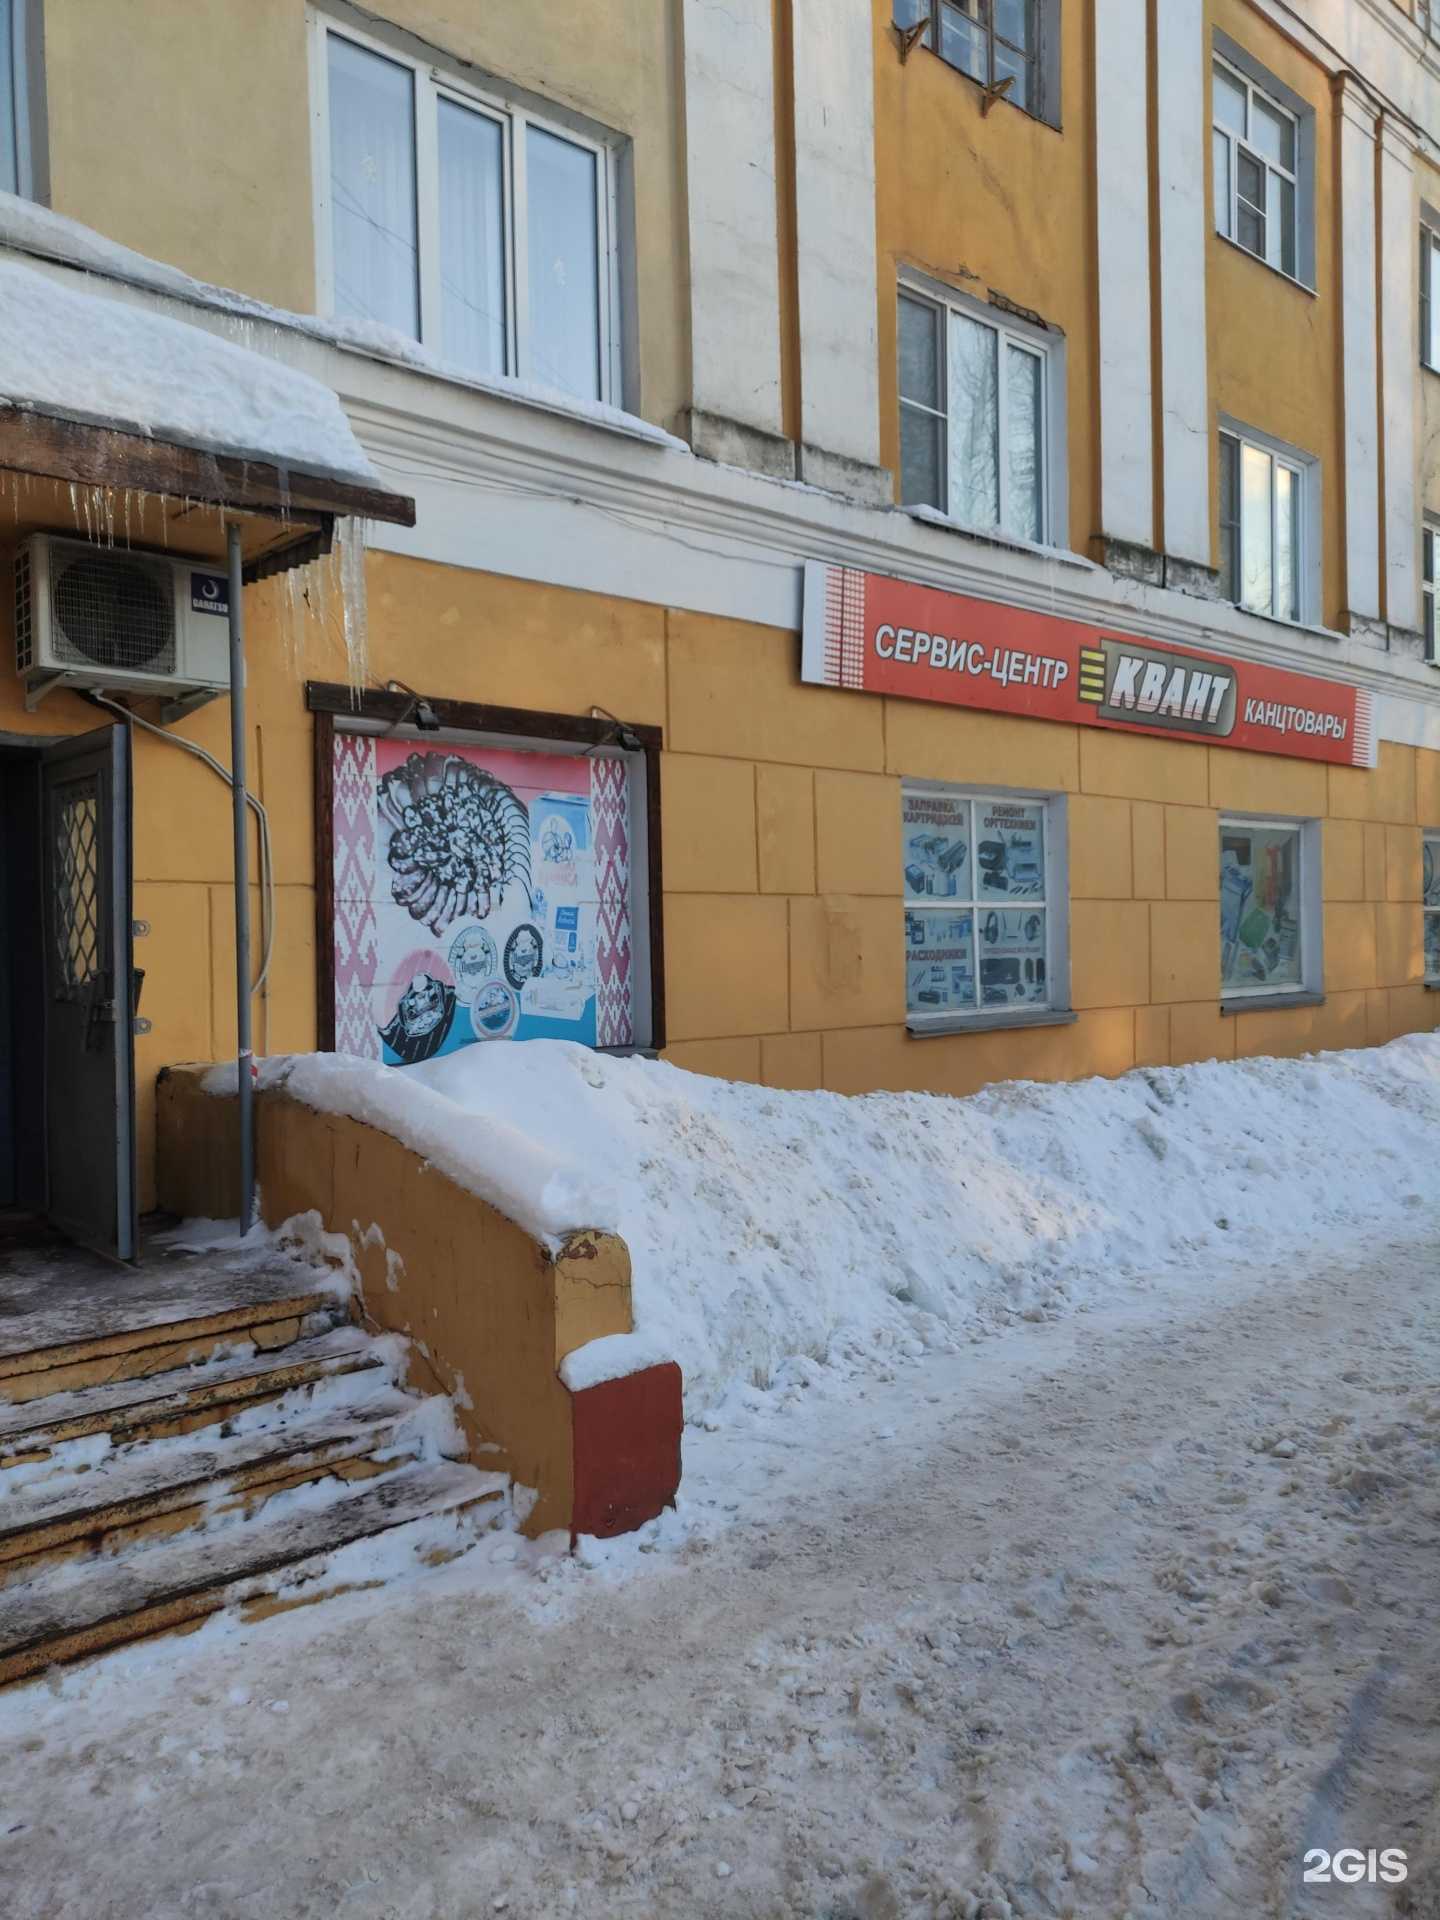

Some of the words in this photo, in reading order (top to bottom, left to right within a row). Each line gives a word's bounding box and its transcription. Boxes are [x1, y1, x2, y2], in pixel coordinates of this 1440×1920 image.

[874, 623, 1069, 689] СЕРВИС-ЦЕНТР
[1108, 654, 1231, 725] КВАНТ
[1243, 697, 1349, 741] КАНЦТОВАРЫ
